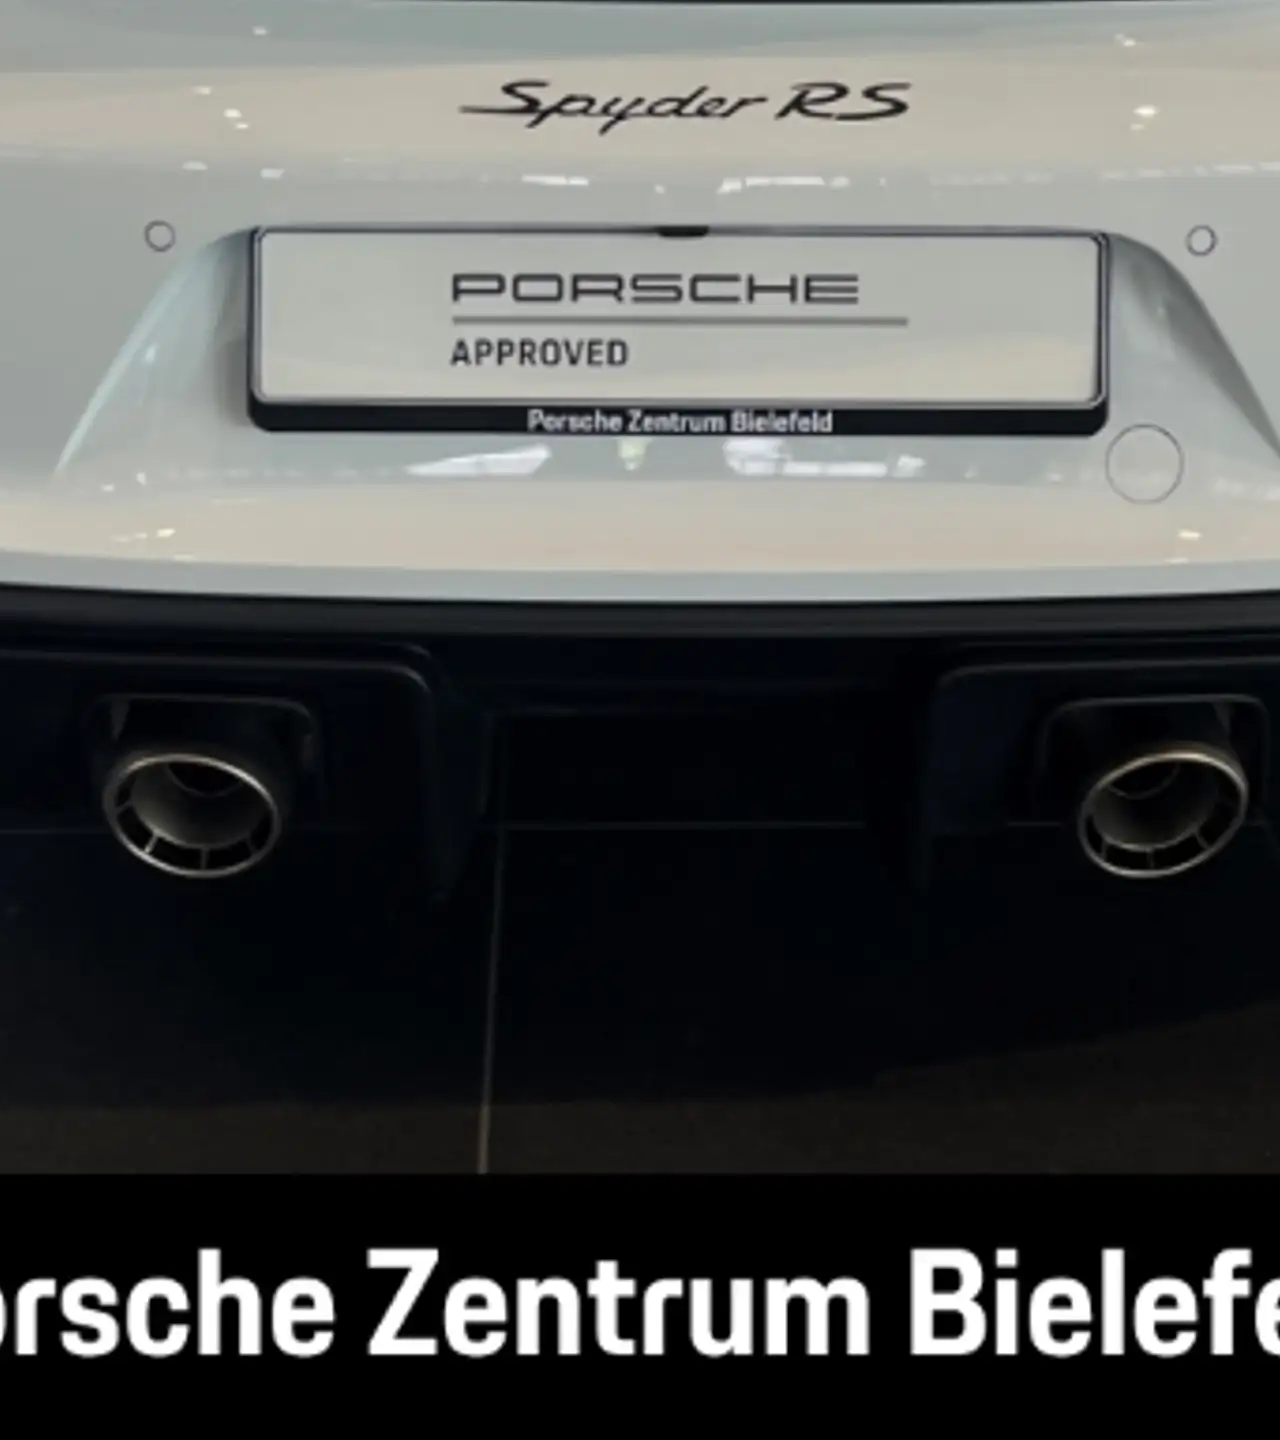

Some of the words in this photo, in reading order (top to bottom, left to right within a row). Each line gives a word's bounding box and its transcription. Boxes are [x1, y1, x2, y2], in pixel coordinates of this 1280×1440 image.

[460, 79, 769, 137] Spyder
[774, 80, 912, 123] RS
[450, 271, 860, 306] PORSCHE
[449, 336, 630, 368] APPROVED
[526, 407, 623, 434] Porsche
[627, 408, 725, 434] Zentrum
[731, 409, 834, 435] Bielefeld
